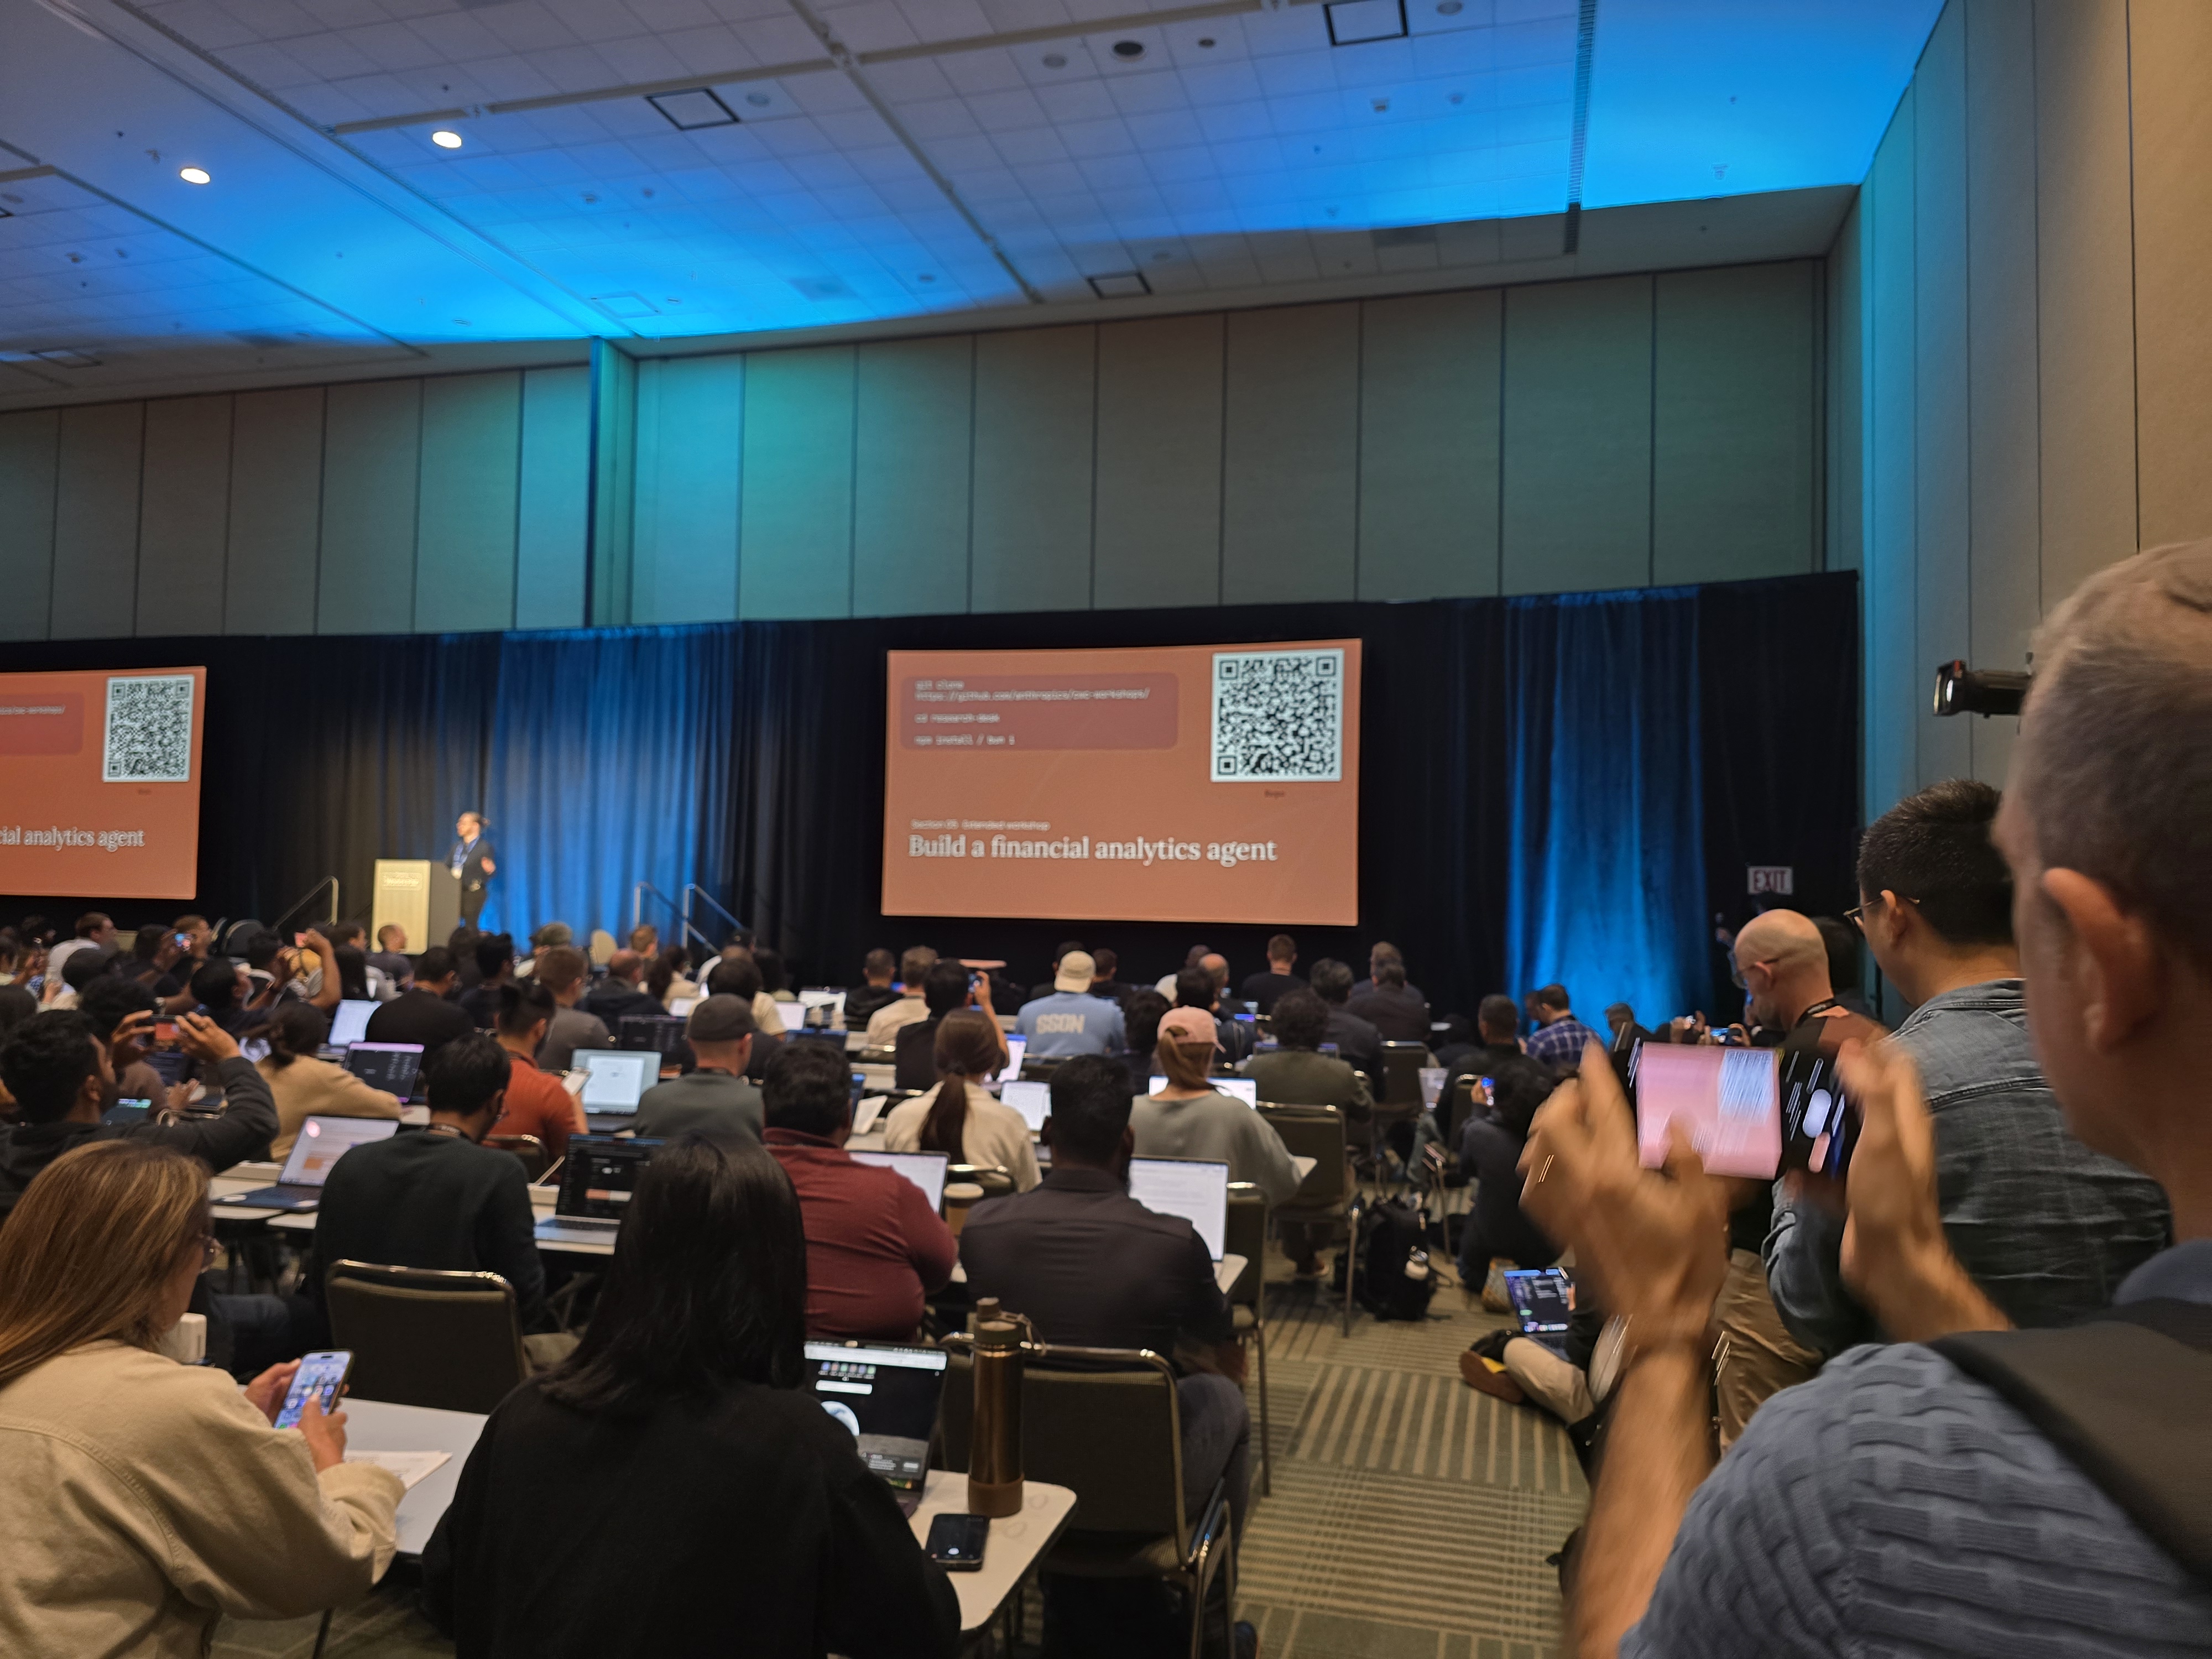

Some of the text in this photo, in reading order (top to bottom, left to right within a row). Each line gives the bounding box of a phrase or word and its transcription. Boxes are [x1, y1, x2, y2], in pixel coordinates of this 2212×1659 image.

[0, 825, 145, 852] ial analytics agent
[909, 834, 1278, 867] Build a financial analytics agent
[1754, 869, 1786, 891] EXIT
